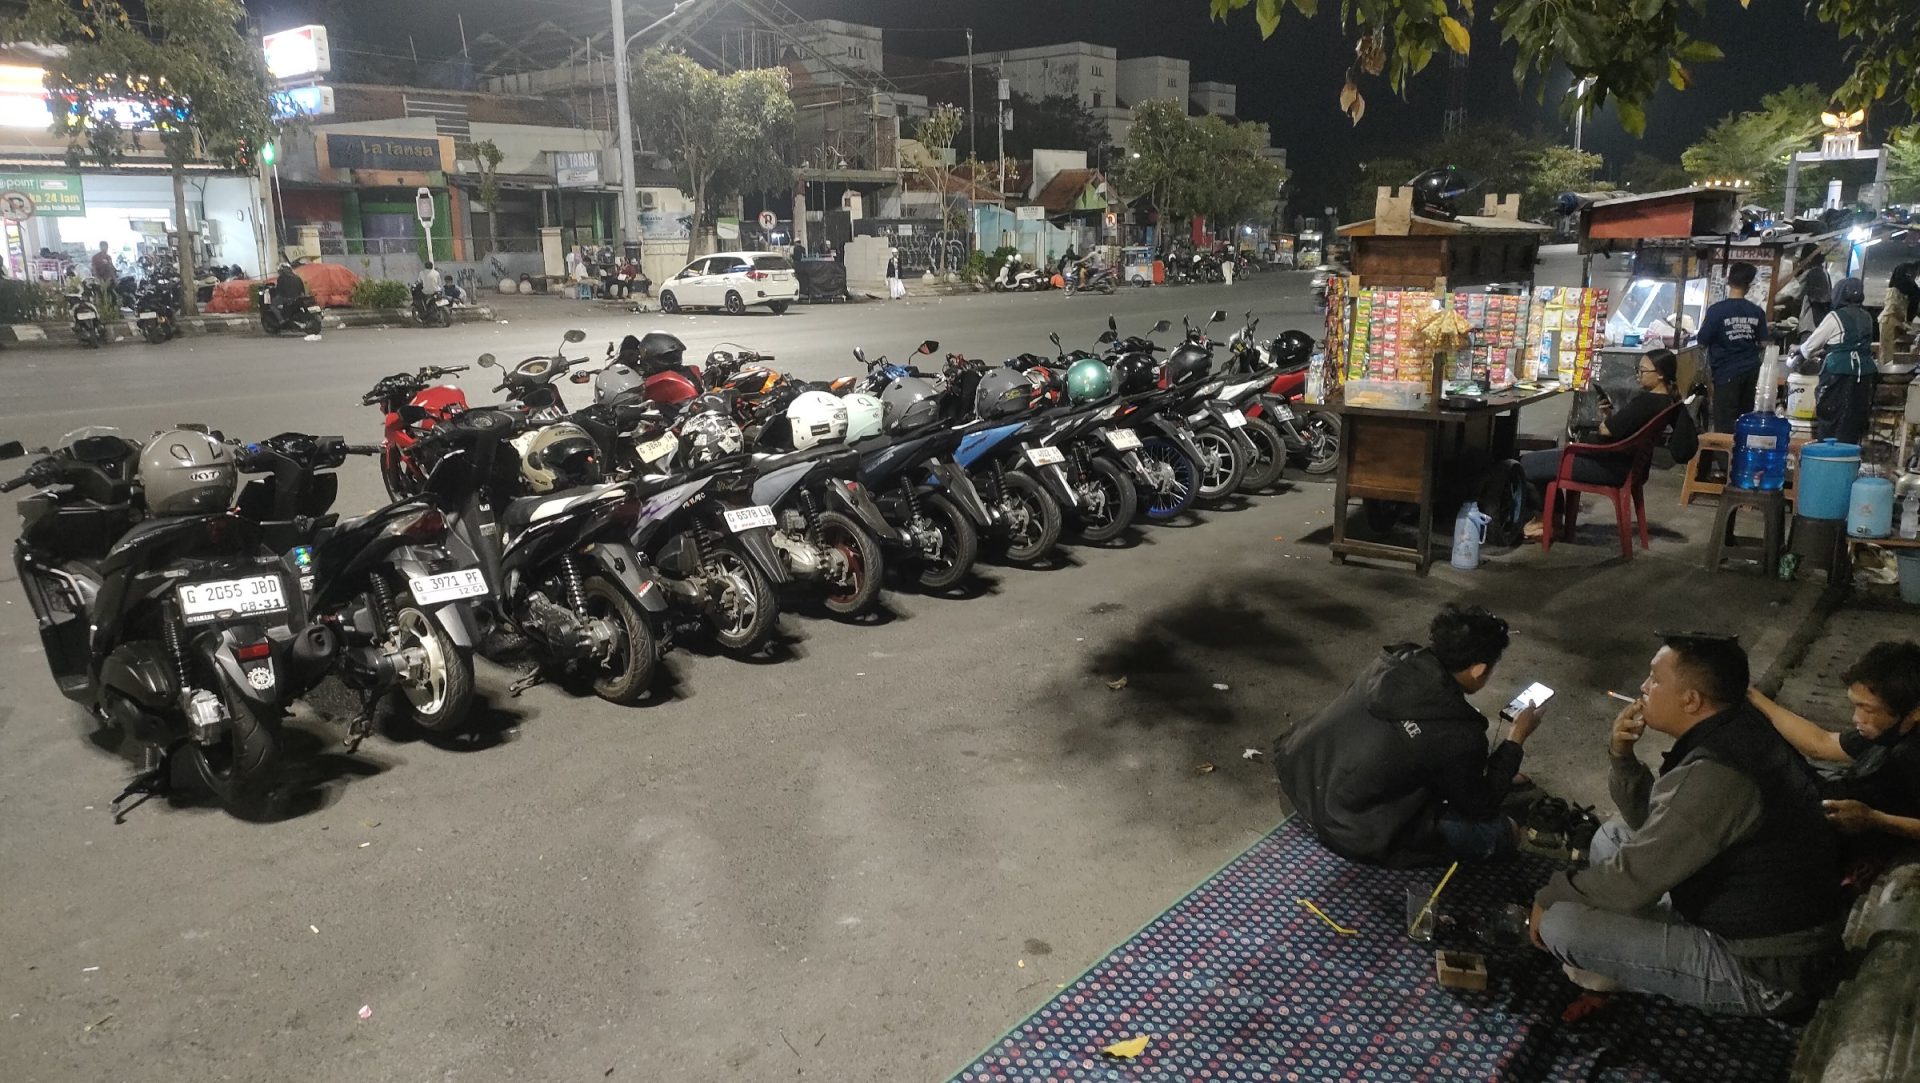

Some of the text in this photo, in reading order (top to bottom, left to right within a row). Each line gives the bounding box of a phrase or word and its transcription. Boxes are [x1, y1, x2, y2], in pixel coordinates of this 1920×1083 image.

[361, 140, 433, 156] La Tansa
[44, 193, 57, 203] 24
[190, 470, 222, 481] KYT
[736, 509, 758, 520] 6578
[414, 571, 477, 593] G 3971 PF
[186, 579, 278, 604] G 2055 JBD
